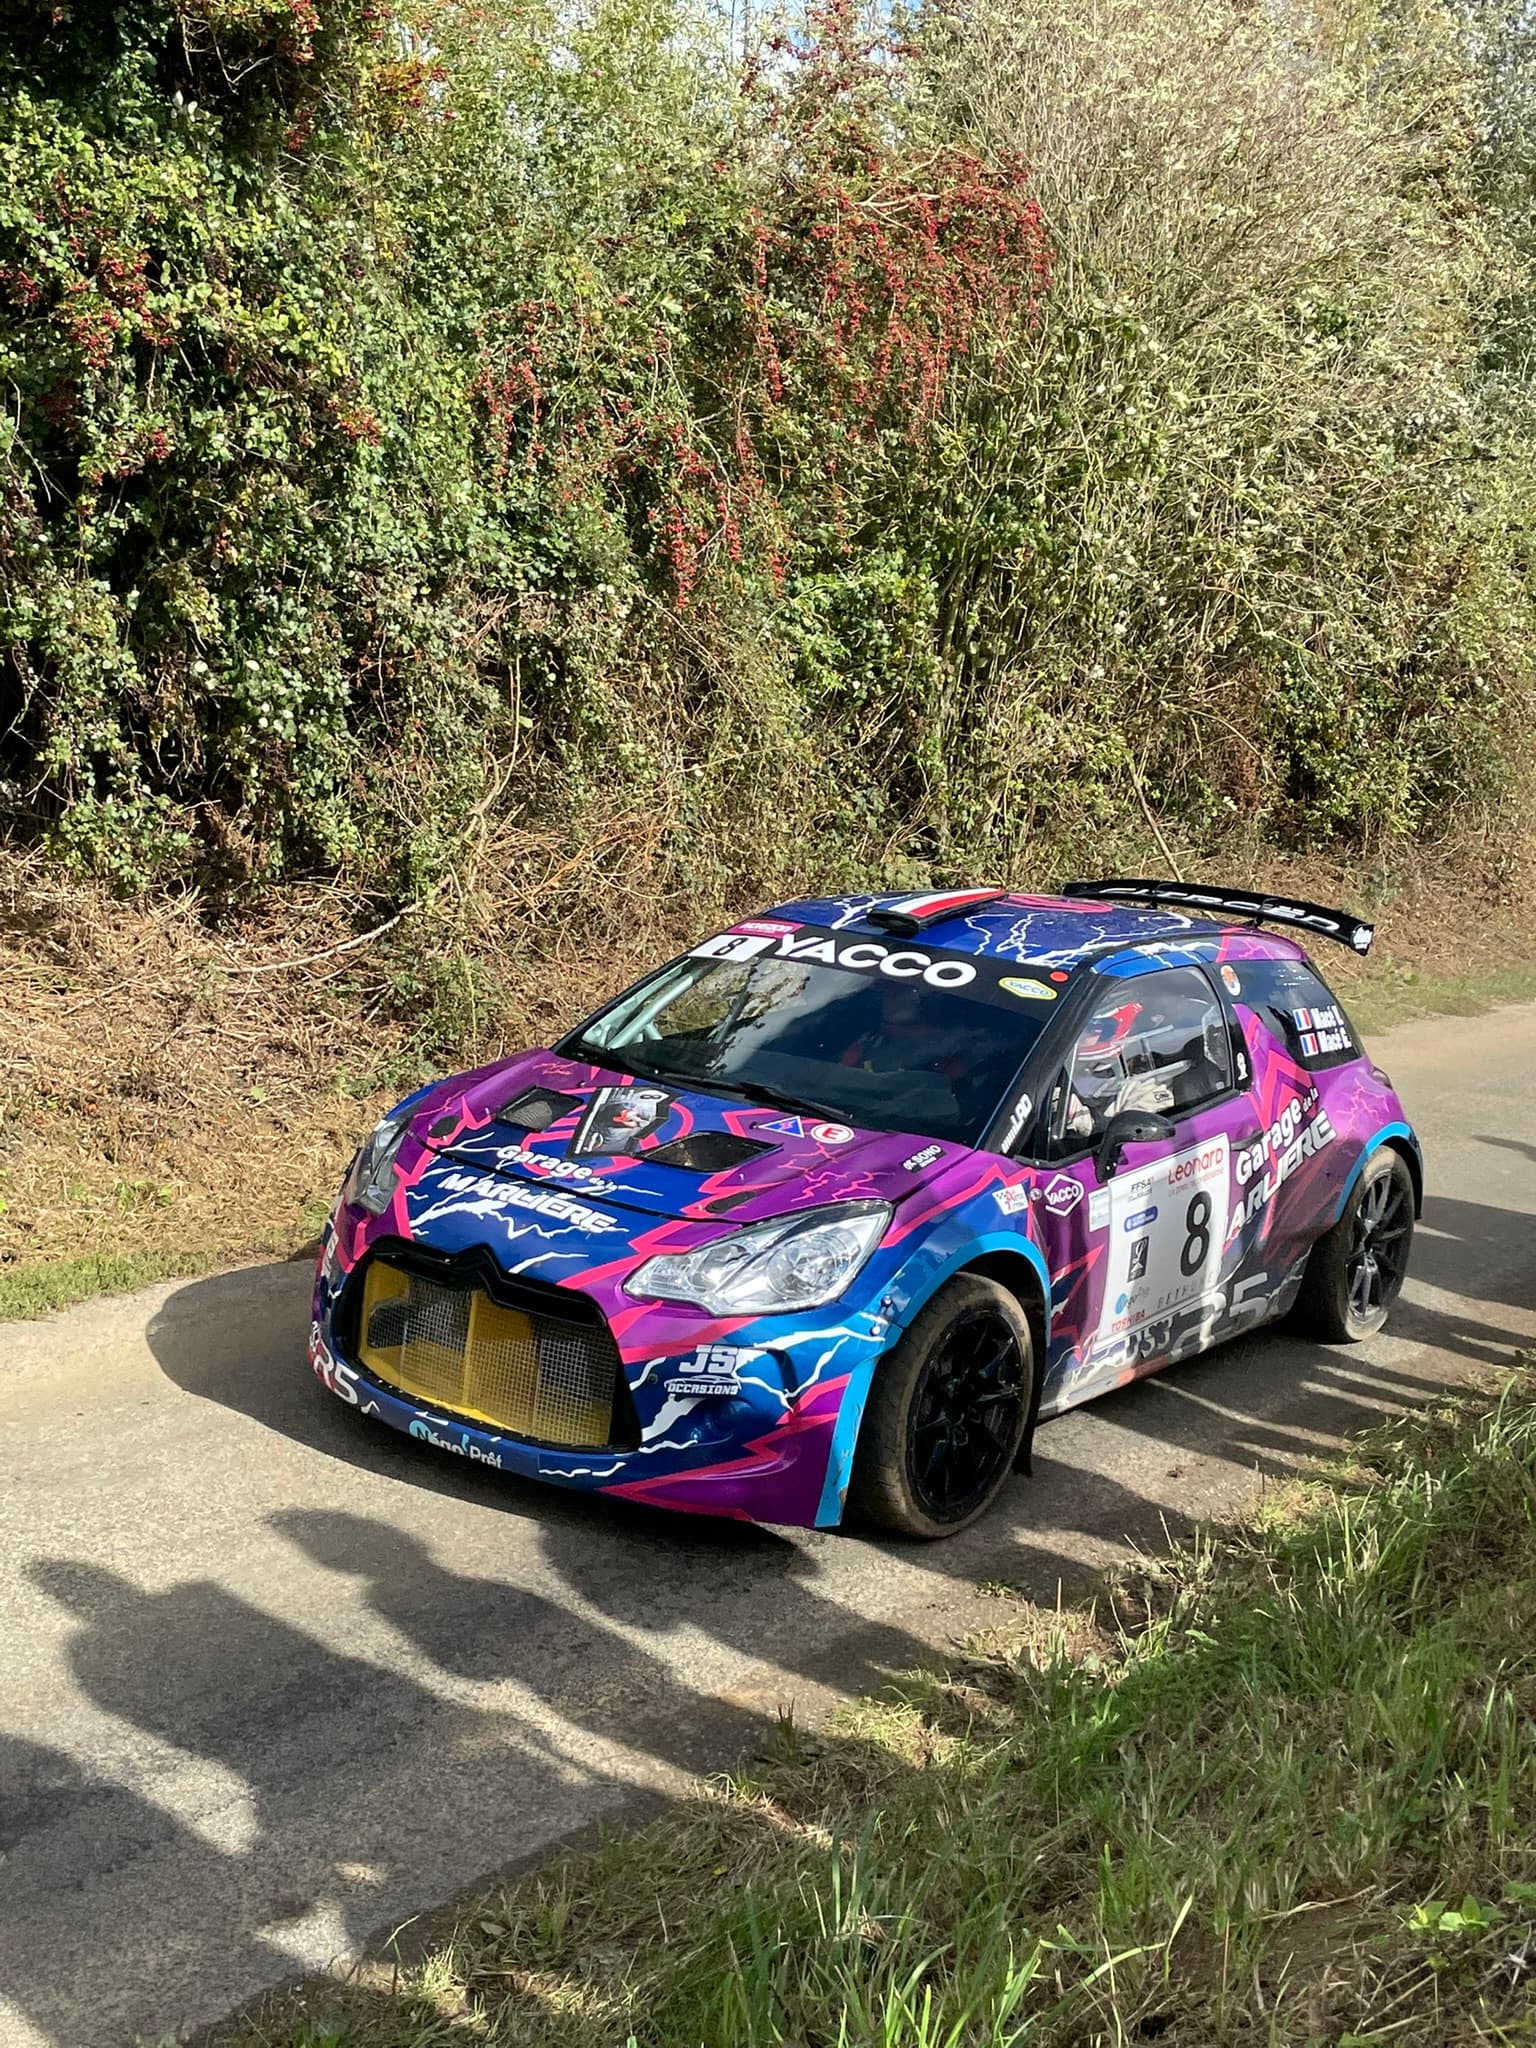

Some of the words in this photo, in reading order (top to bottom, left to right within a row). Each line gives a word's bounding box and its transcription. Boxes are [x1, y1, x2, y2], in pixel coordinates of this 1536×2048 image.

[712, 937, 749, 956] 8
[774, 934, 977, 988] YACCO
[1008, 979, 1051, 997] YACCO
[822, 1127, 844, 1140] E
[1236, 1098, 1302, 1185] Garage
[496, 1145, 593, 1178] Garage
[1047, 1185, 1079, 1206] YACCO
[1181, 1190, 1213, 1277] 8
[678, 1344, 739, 1374] JS
[667, 1383, 739, 1396] OCCASIONS
